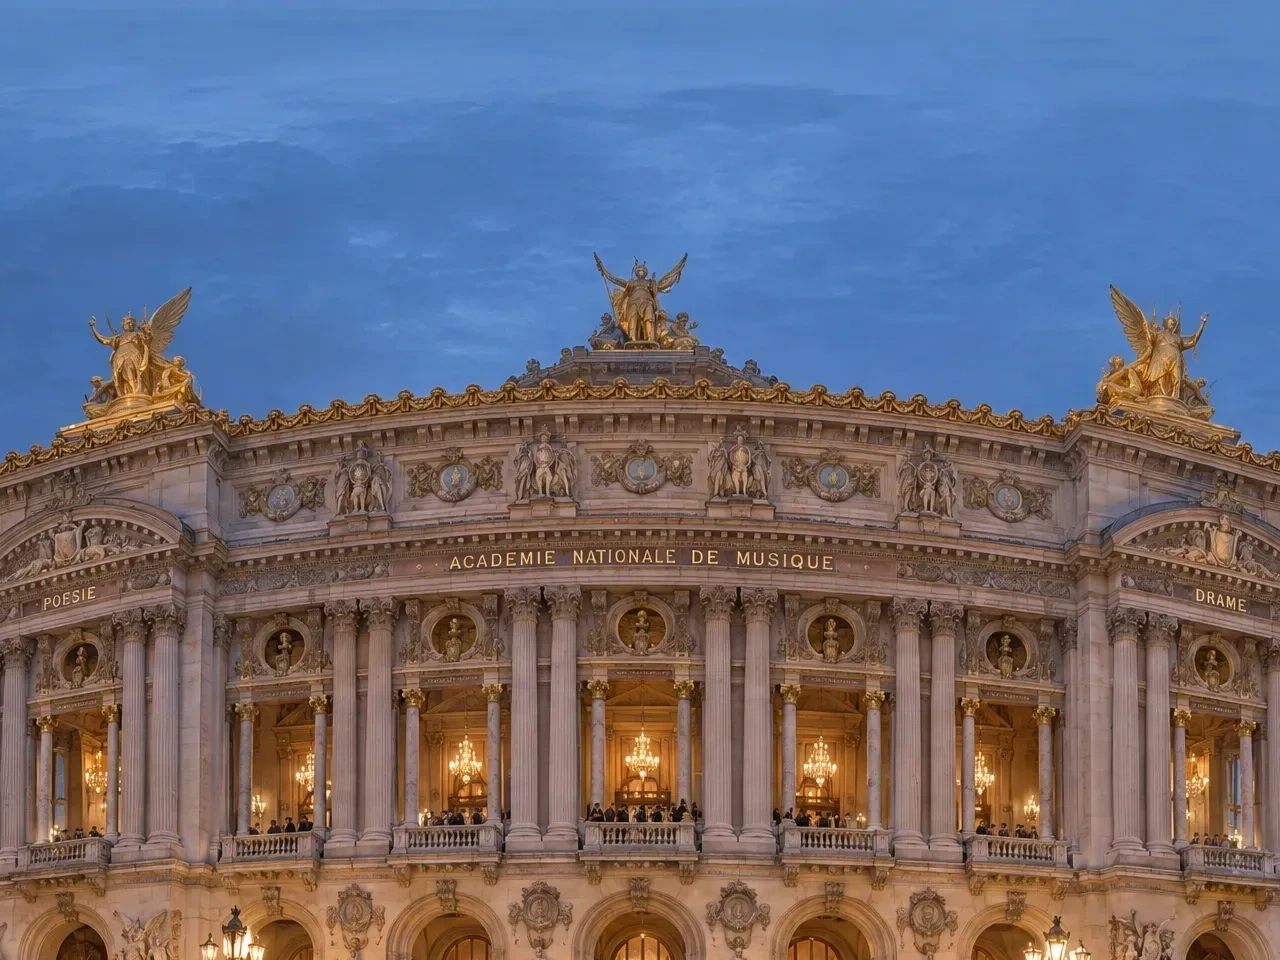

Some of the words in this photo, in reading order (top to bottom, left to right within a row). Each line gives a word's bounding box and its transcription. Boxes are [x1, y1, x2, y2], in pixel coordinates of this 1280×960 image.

[450, 551, 556, 569] ACADEMIE
[573, 549, 676, 565] NATIONALE
[691, 550, 719, 565] DE
[736, 551, 834, 570] MUSIQUE
[43, 586, 96, 611] POESIE
[1195, 588, 1247, 612] DRAME
